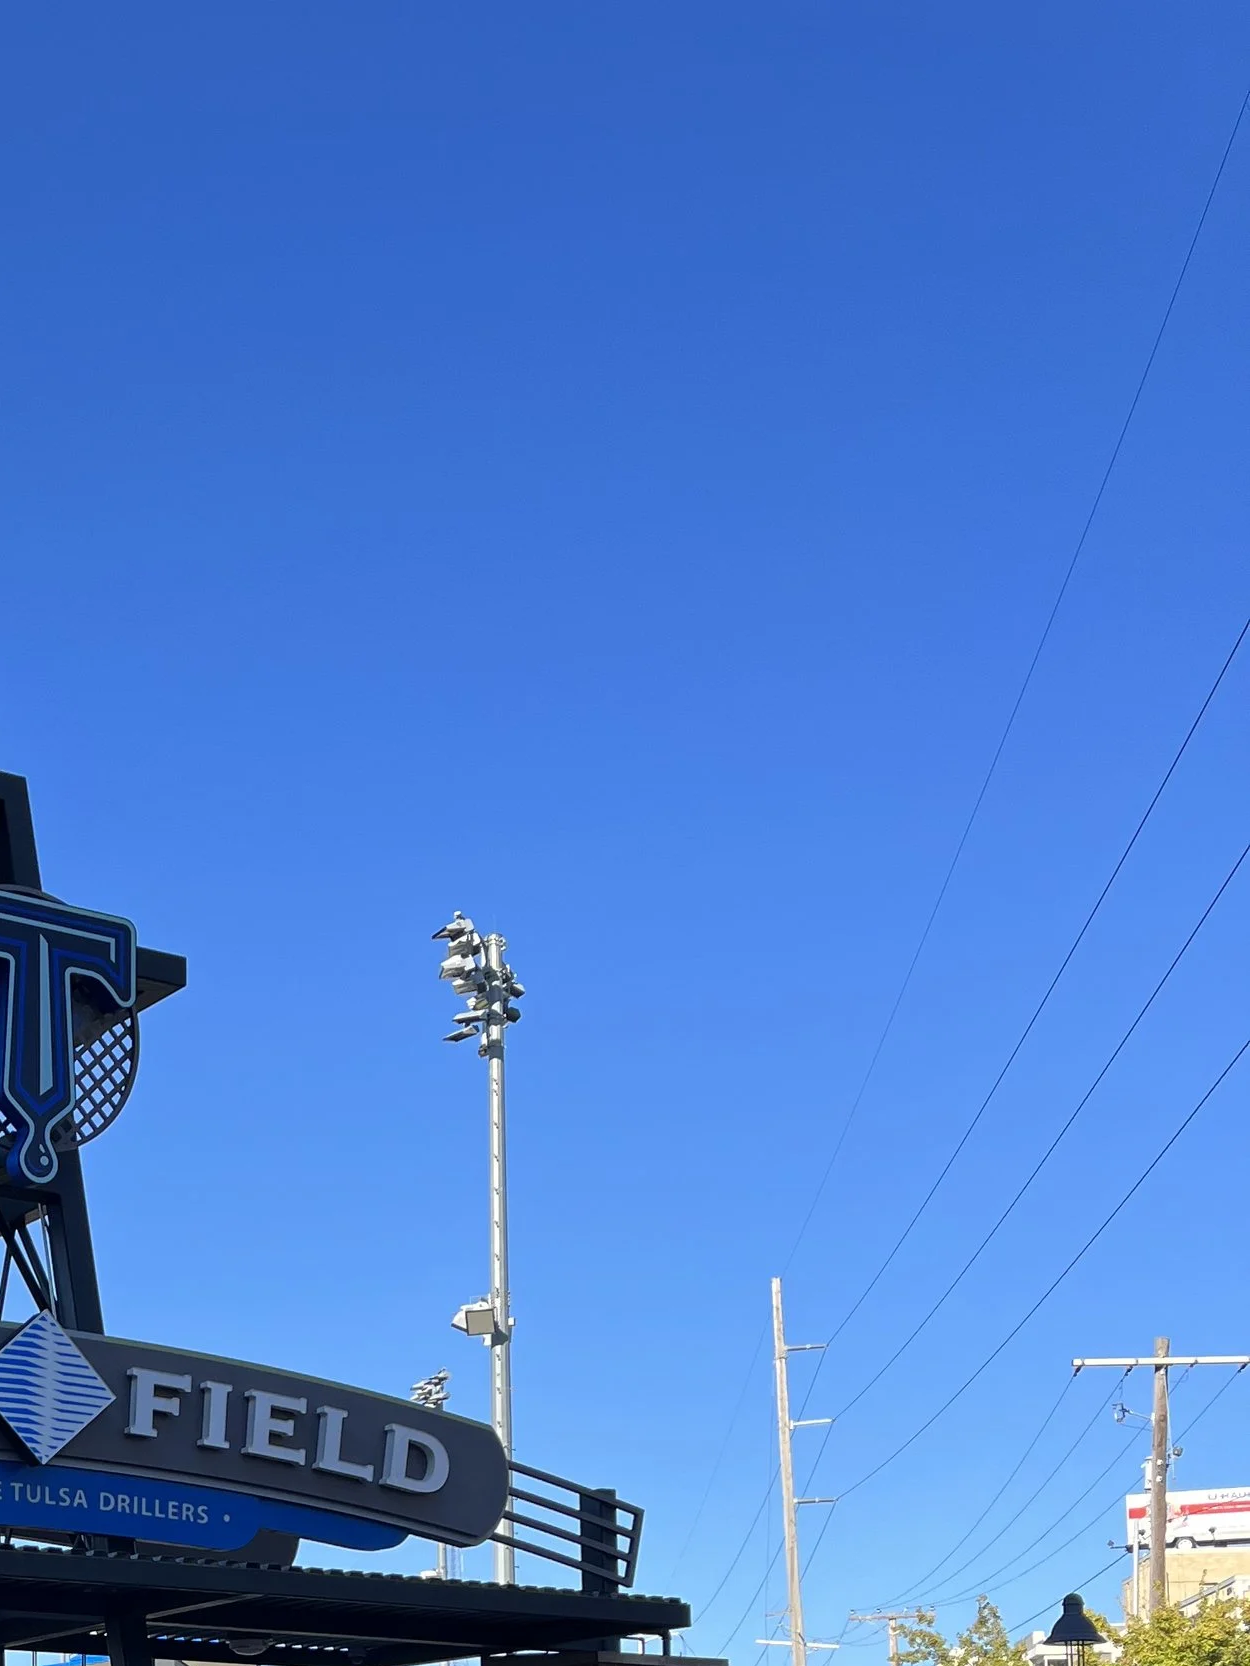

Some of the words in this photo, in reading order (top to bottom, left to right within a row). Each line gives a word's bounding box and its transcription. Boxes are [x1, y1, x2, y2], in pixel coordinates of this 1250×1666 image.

[125, 1366, 451, 1497] FIELD
[10, 1482, 88, 1509] TULSA
[99, 1492, 209, 1524] DRILLERS
